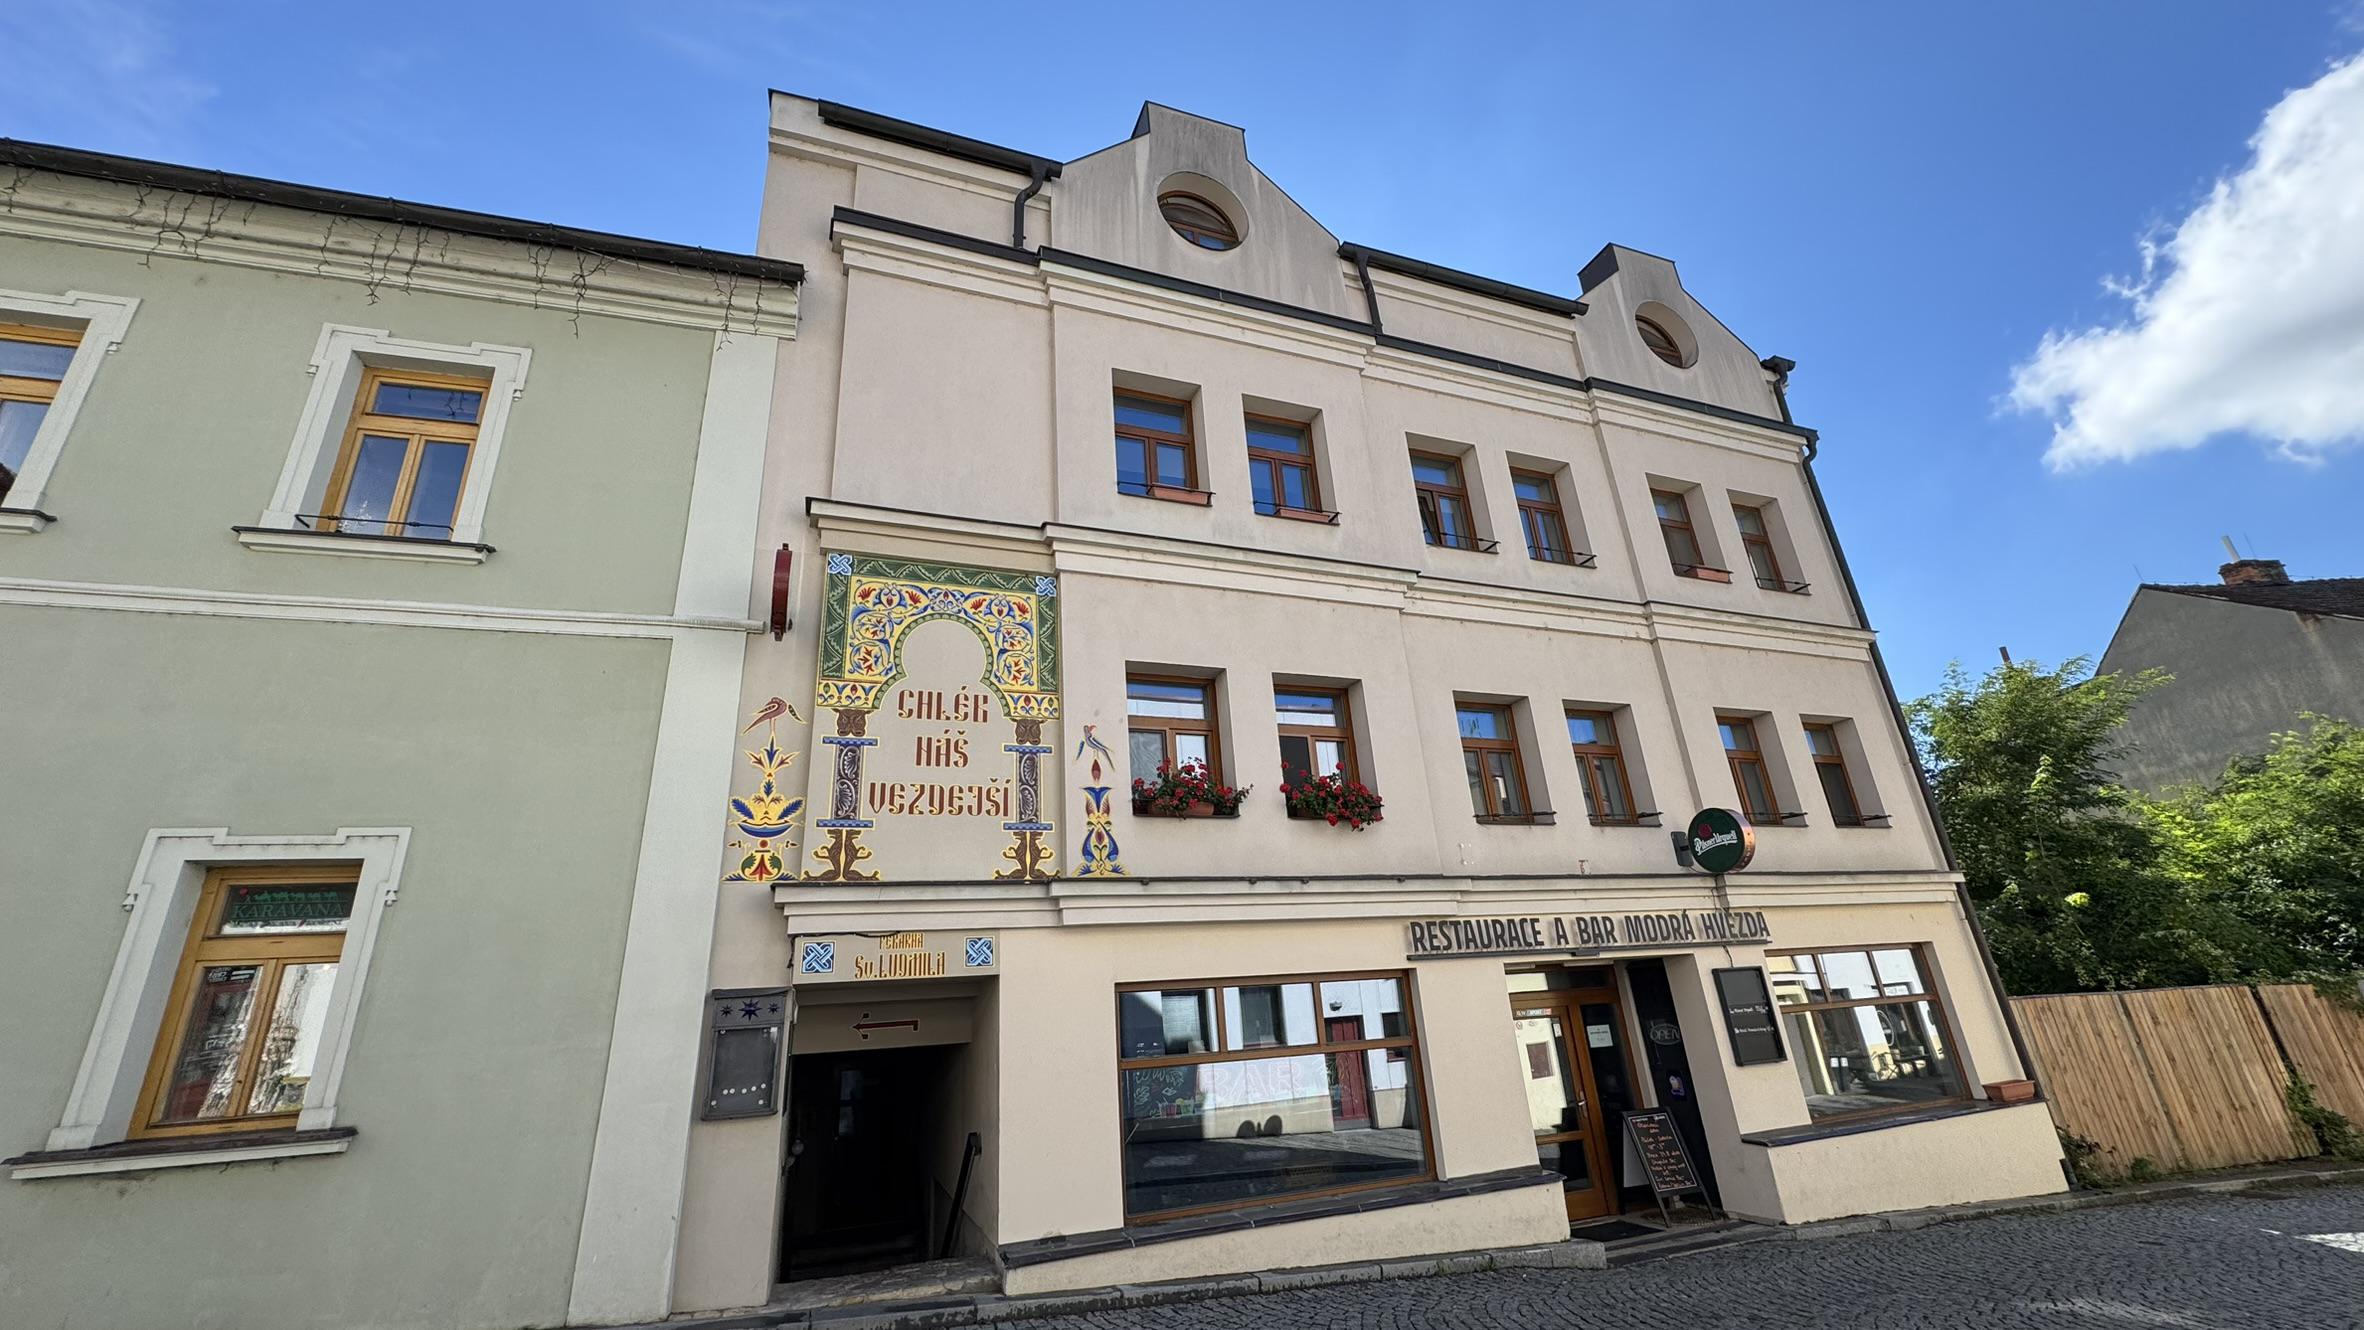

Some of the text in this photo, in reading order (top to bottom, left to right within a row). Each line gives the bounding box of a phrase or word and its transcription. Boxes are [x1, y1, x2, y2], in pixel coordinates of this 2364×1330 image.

[916, 729, 969, 767] NÁŠ
[869, 778, 1011, 817] VEZDEJŠÍ
[1694, 830, 1738, 856] Pilsner Urquell
[232, 902, 344, 918] KARAVANA
[1410, 918, 1545, 952] RESTAURACE
[1555, 917, 1570, 945] A
[1576, 915, 1619, 945] BAR
[1624, 909, 1696, 943] MODRÁ
[1650, 1029, 1680, 1041] OPEN
